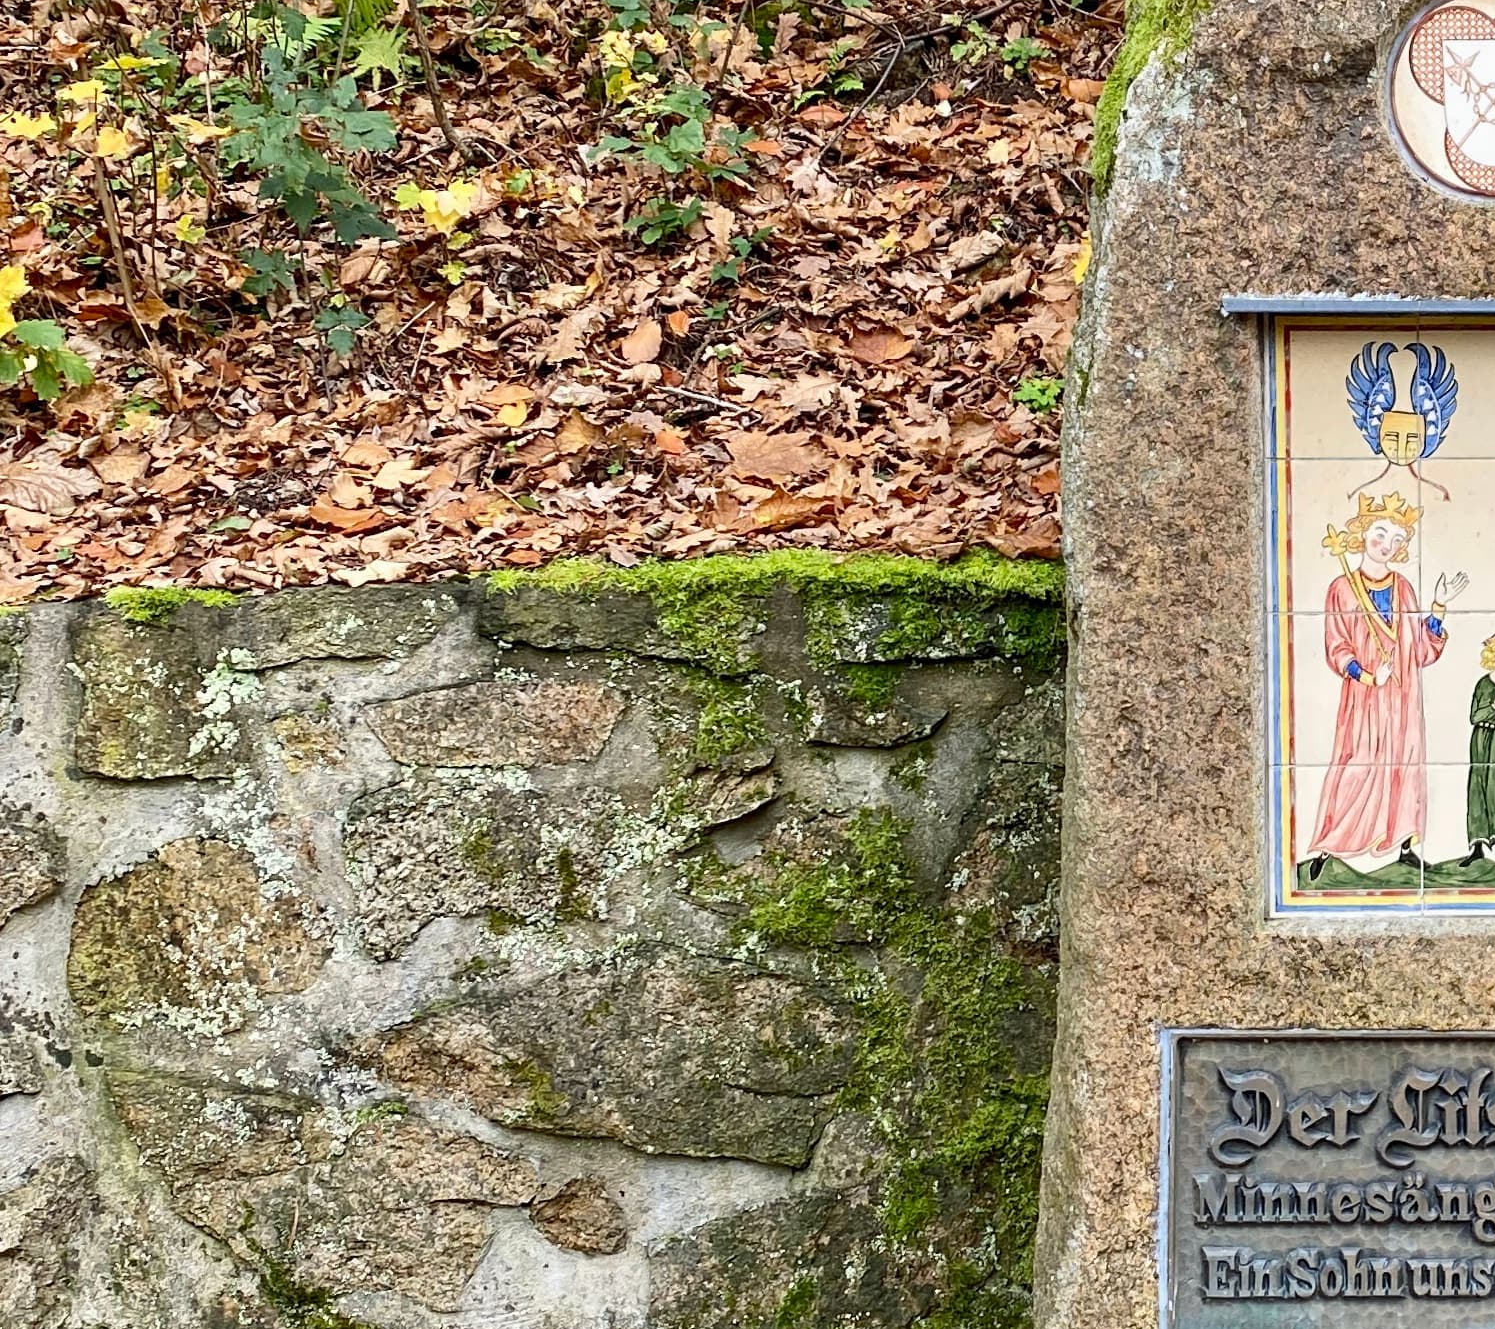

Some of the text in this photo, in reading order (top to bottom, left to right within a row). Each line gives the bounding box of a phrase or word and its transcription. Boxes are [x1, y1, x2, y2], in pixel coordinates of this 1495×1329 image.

[1208, 1067, 1381, 1167] Der
[1202, 1245, 1287, 1298] Ein
[1286, 1245, 1403, 1298] Sohn
